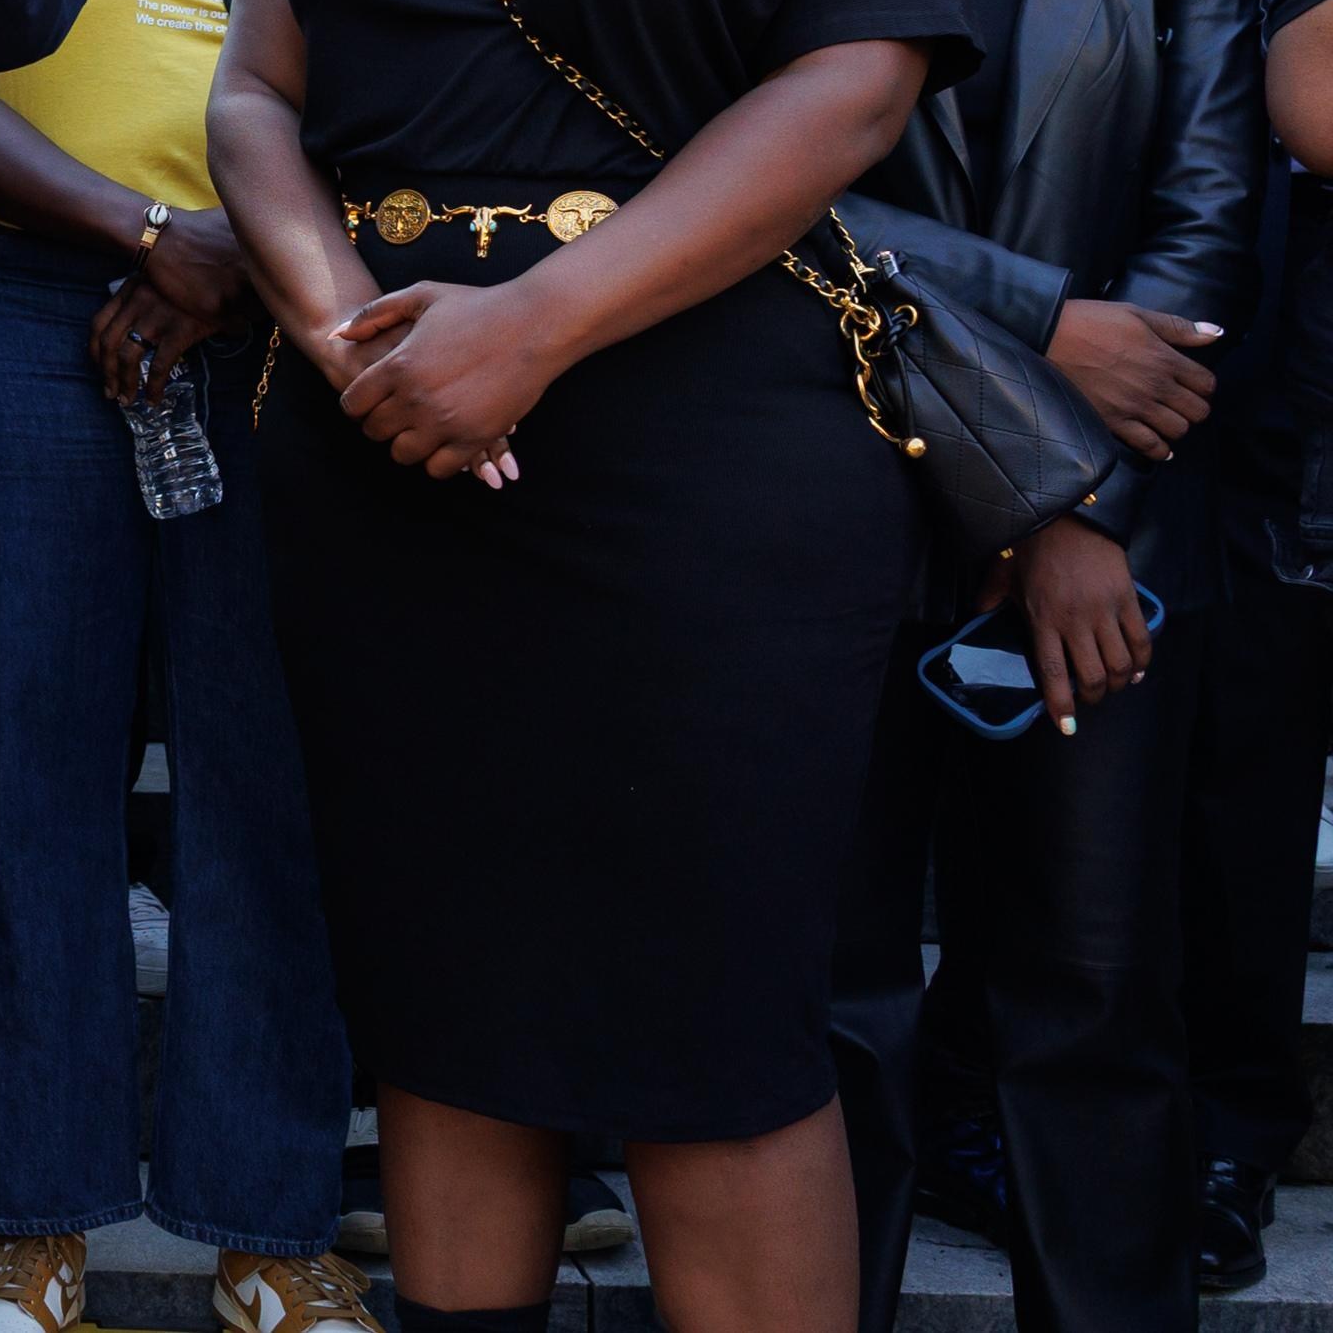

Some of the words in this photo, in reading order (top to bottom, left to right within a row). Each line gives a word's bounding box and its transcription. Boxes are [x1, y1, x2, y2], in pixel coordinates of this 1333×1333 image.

[161, 2, 196, 17] power
[199, 7, 208, 18] is
[136, 13, 154, 26] We
[157, 17, 192, 31] create
[195, 21, 213, 32] the
